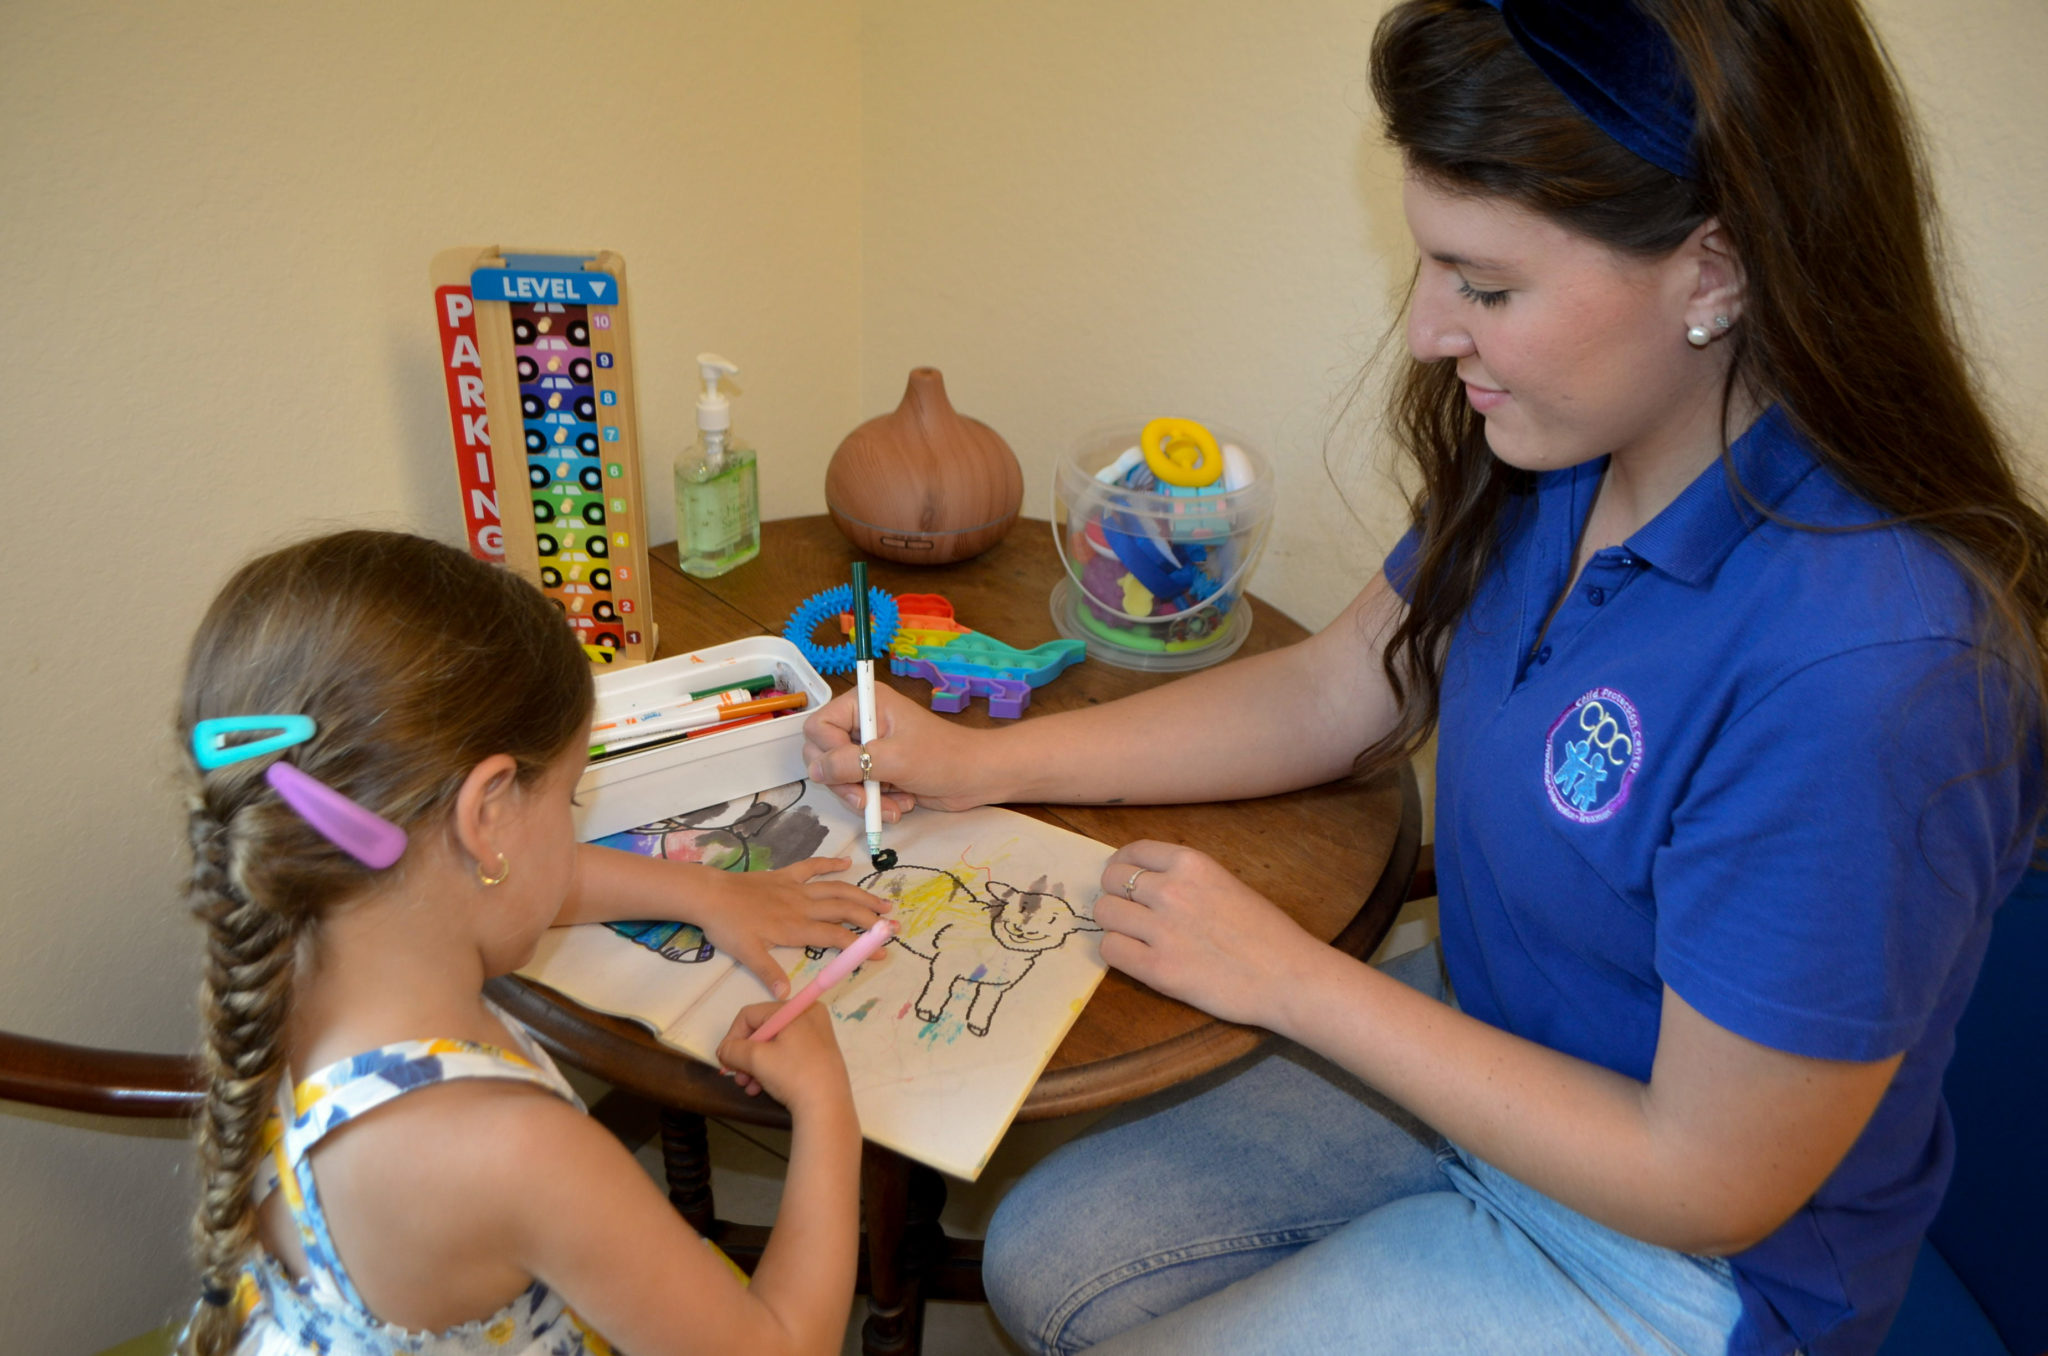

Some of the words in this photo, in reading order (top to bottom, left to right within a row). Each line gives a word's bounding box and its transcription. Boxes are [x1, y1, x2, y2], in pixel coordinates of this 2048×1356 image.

[502, 276, 581, 300] LEVEL
[593, 315, 610, 329] 10
[600, 354, 610, 367] 9
[603, 393, 613, 405] 8
[445, 293, 506, 555] PARKING
[606, 429, 616, 441] 7
[610, 465, 619, 477] 6
[613, 501, 622, 512] 5
[616, 534, 625, 545] 4
[619, 568, 628, 579] 3
[622, 601, 631, 612] 2
[629, 633, 638, 643] 1
[1575, 687, 1600, 707] Child
